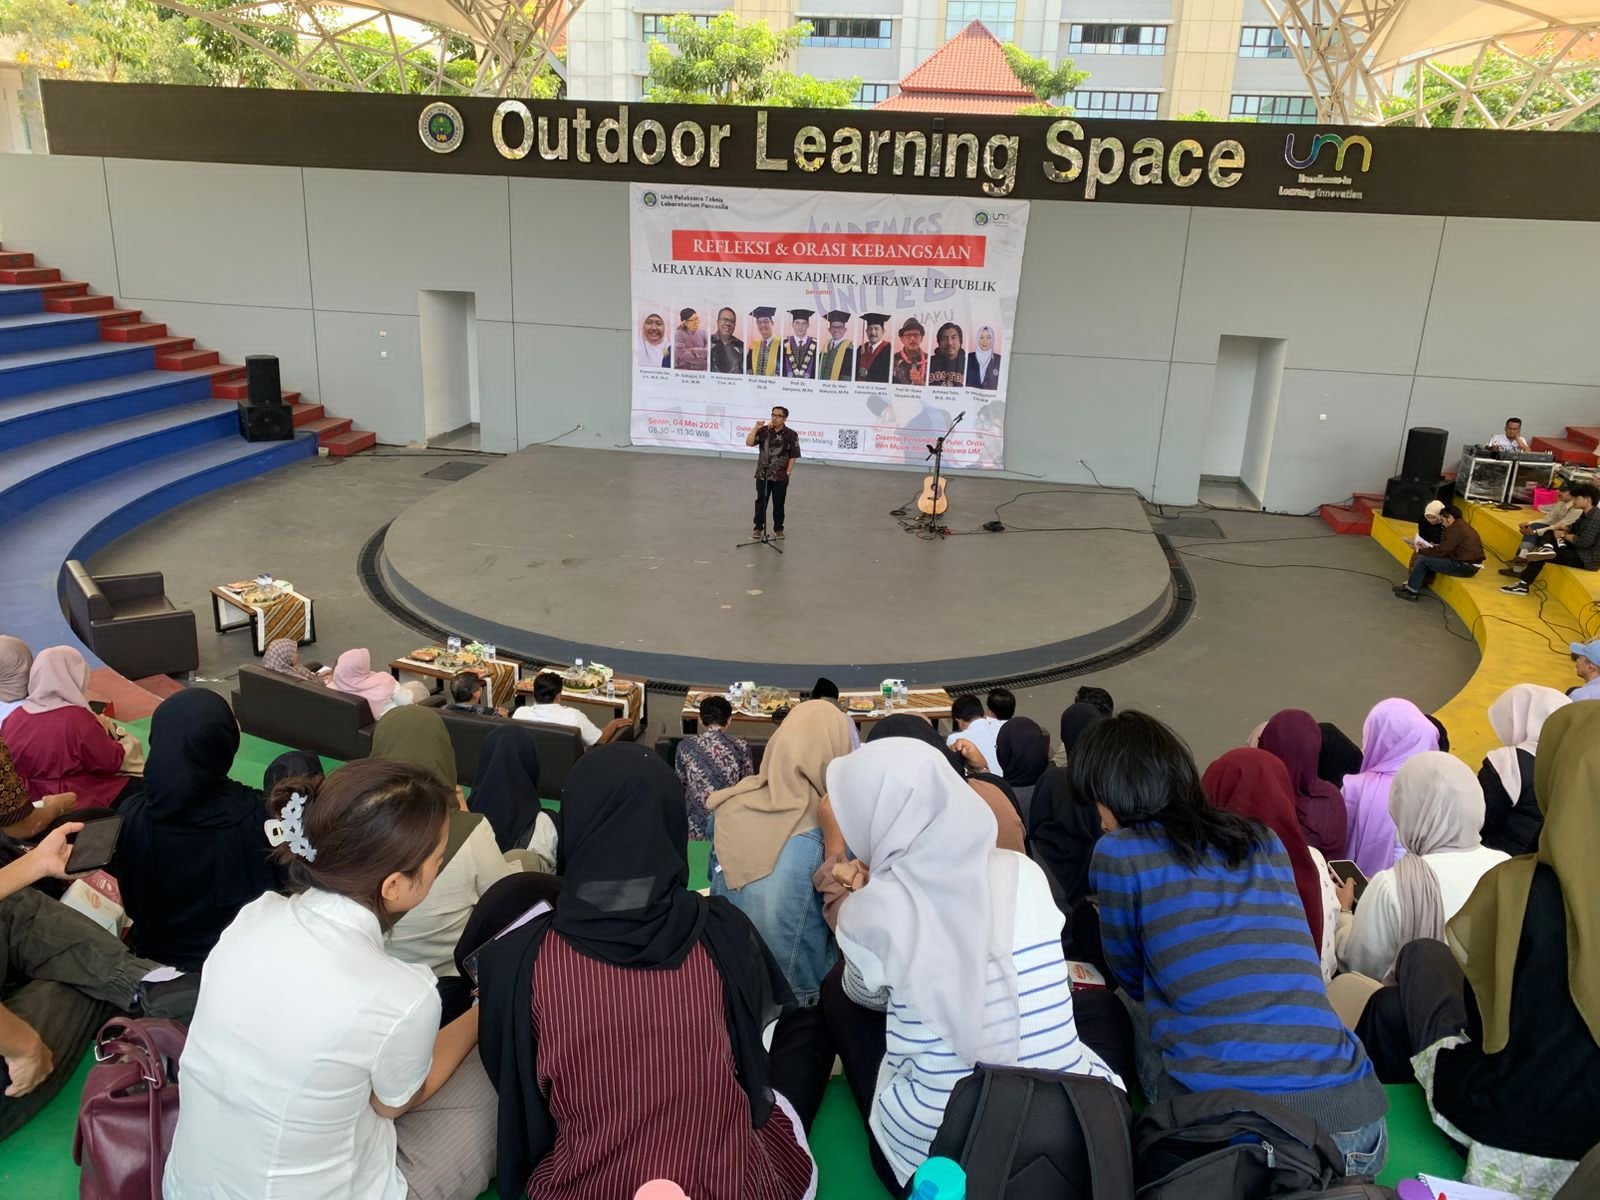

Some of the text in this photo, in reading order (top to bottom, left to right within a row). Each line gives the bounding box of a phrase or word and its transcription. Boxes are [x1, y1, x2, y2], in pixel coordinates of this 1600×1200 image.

[491, 99, 732, 169] Outdoor
[754, 109, 1021, 198] Learning
[1043, 119, 1246, 201] Space
[1278, 185, 1316, 199] Learning
[692, 238, 972, 260] REFLEKSI & ORASI KEBANGSAAN
[651, 263, 997, 292] MERAYAKAN RUANG AKADEMIK, MERAWAT REPUBLIK
[683, 419, 698, 428] Mei
[695, 430, 711, 438] WIB
